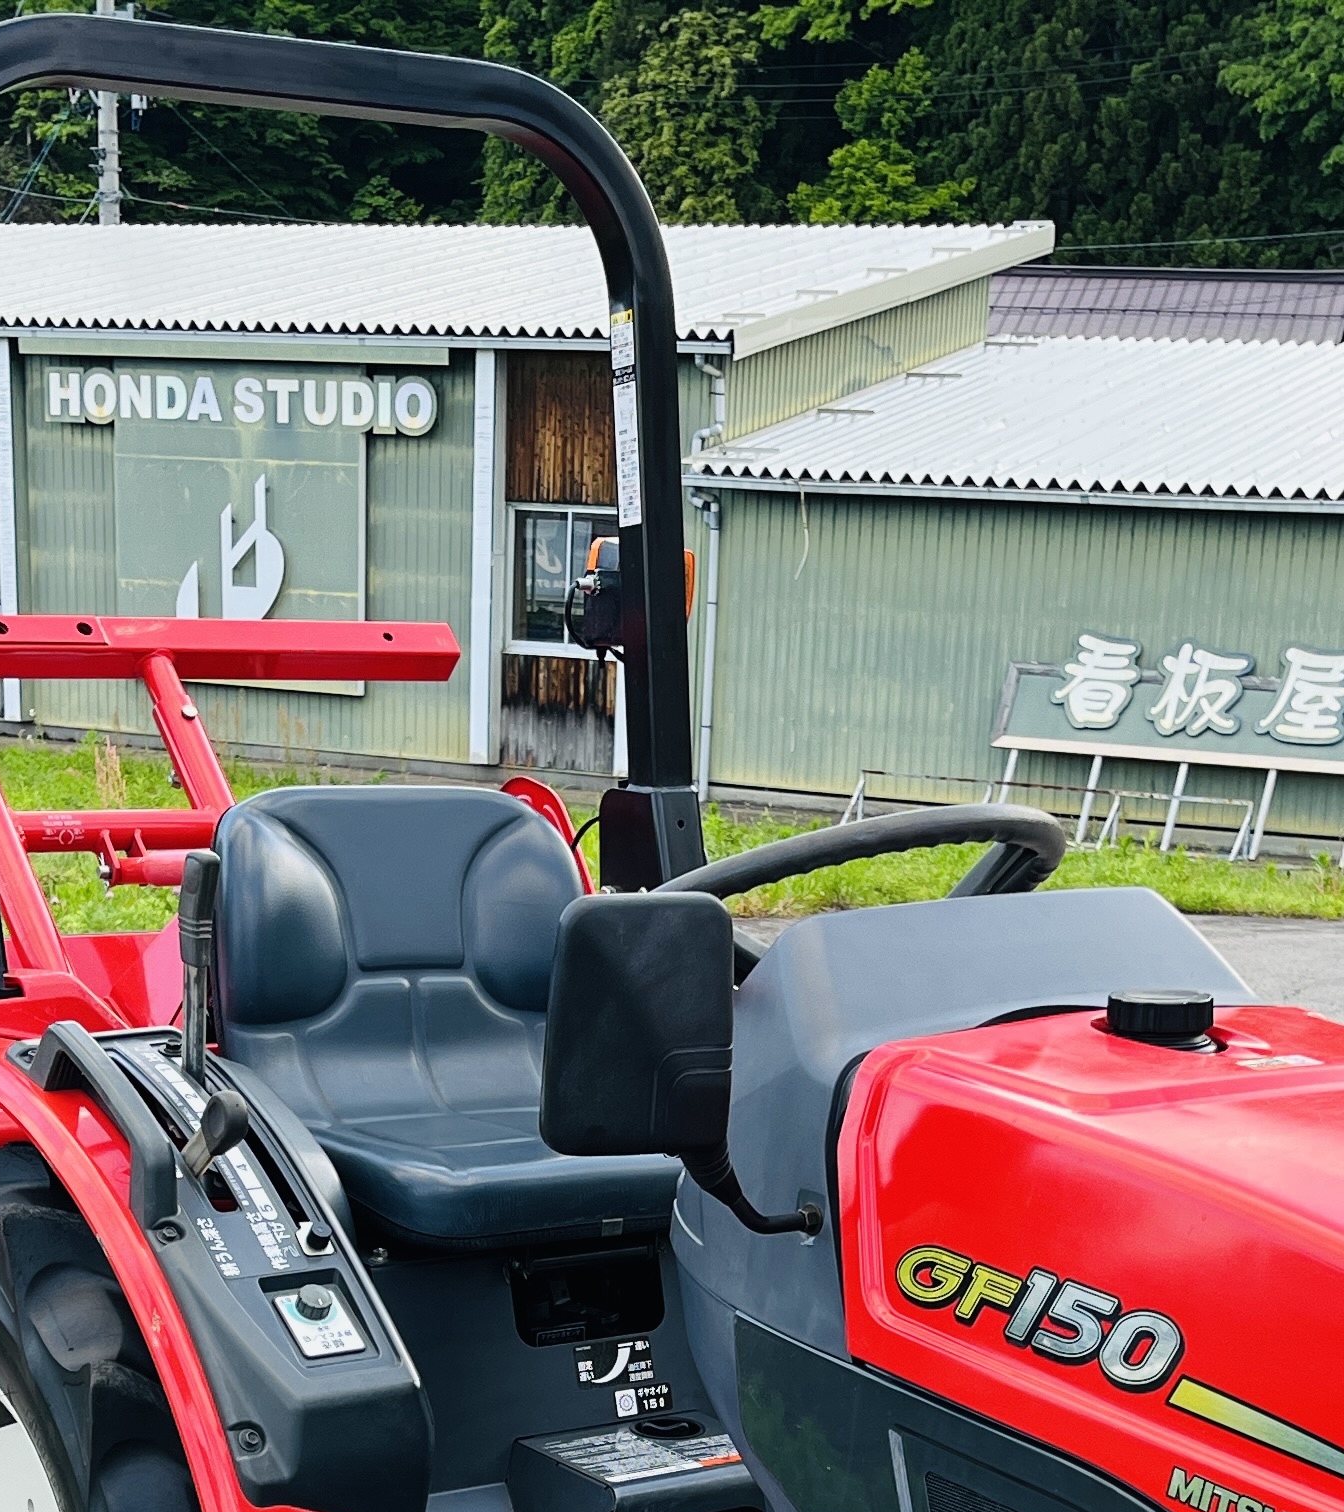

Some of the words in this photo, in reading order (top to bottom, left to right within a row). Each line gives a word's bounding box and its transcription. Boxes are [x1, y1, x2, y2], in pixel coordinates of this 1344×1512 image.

[46, 370, 223, 424] HONDA
[233, 376, 437, 434] STUDIO
[895, 1244, 1185, 1390] GF150
